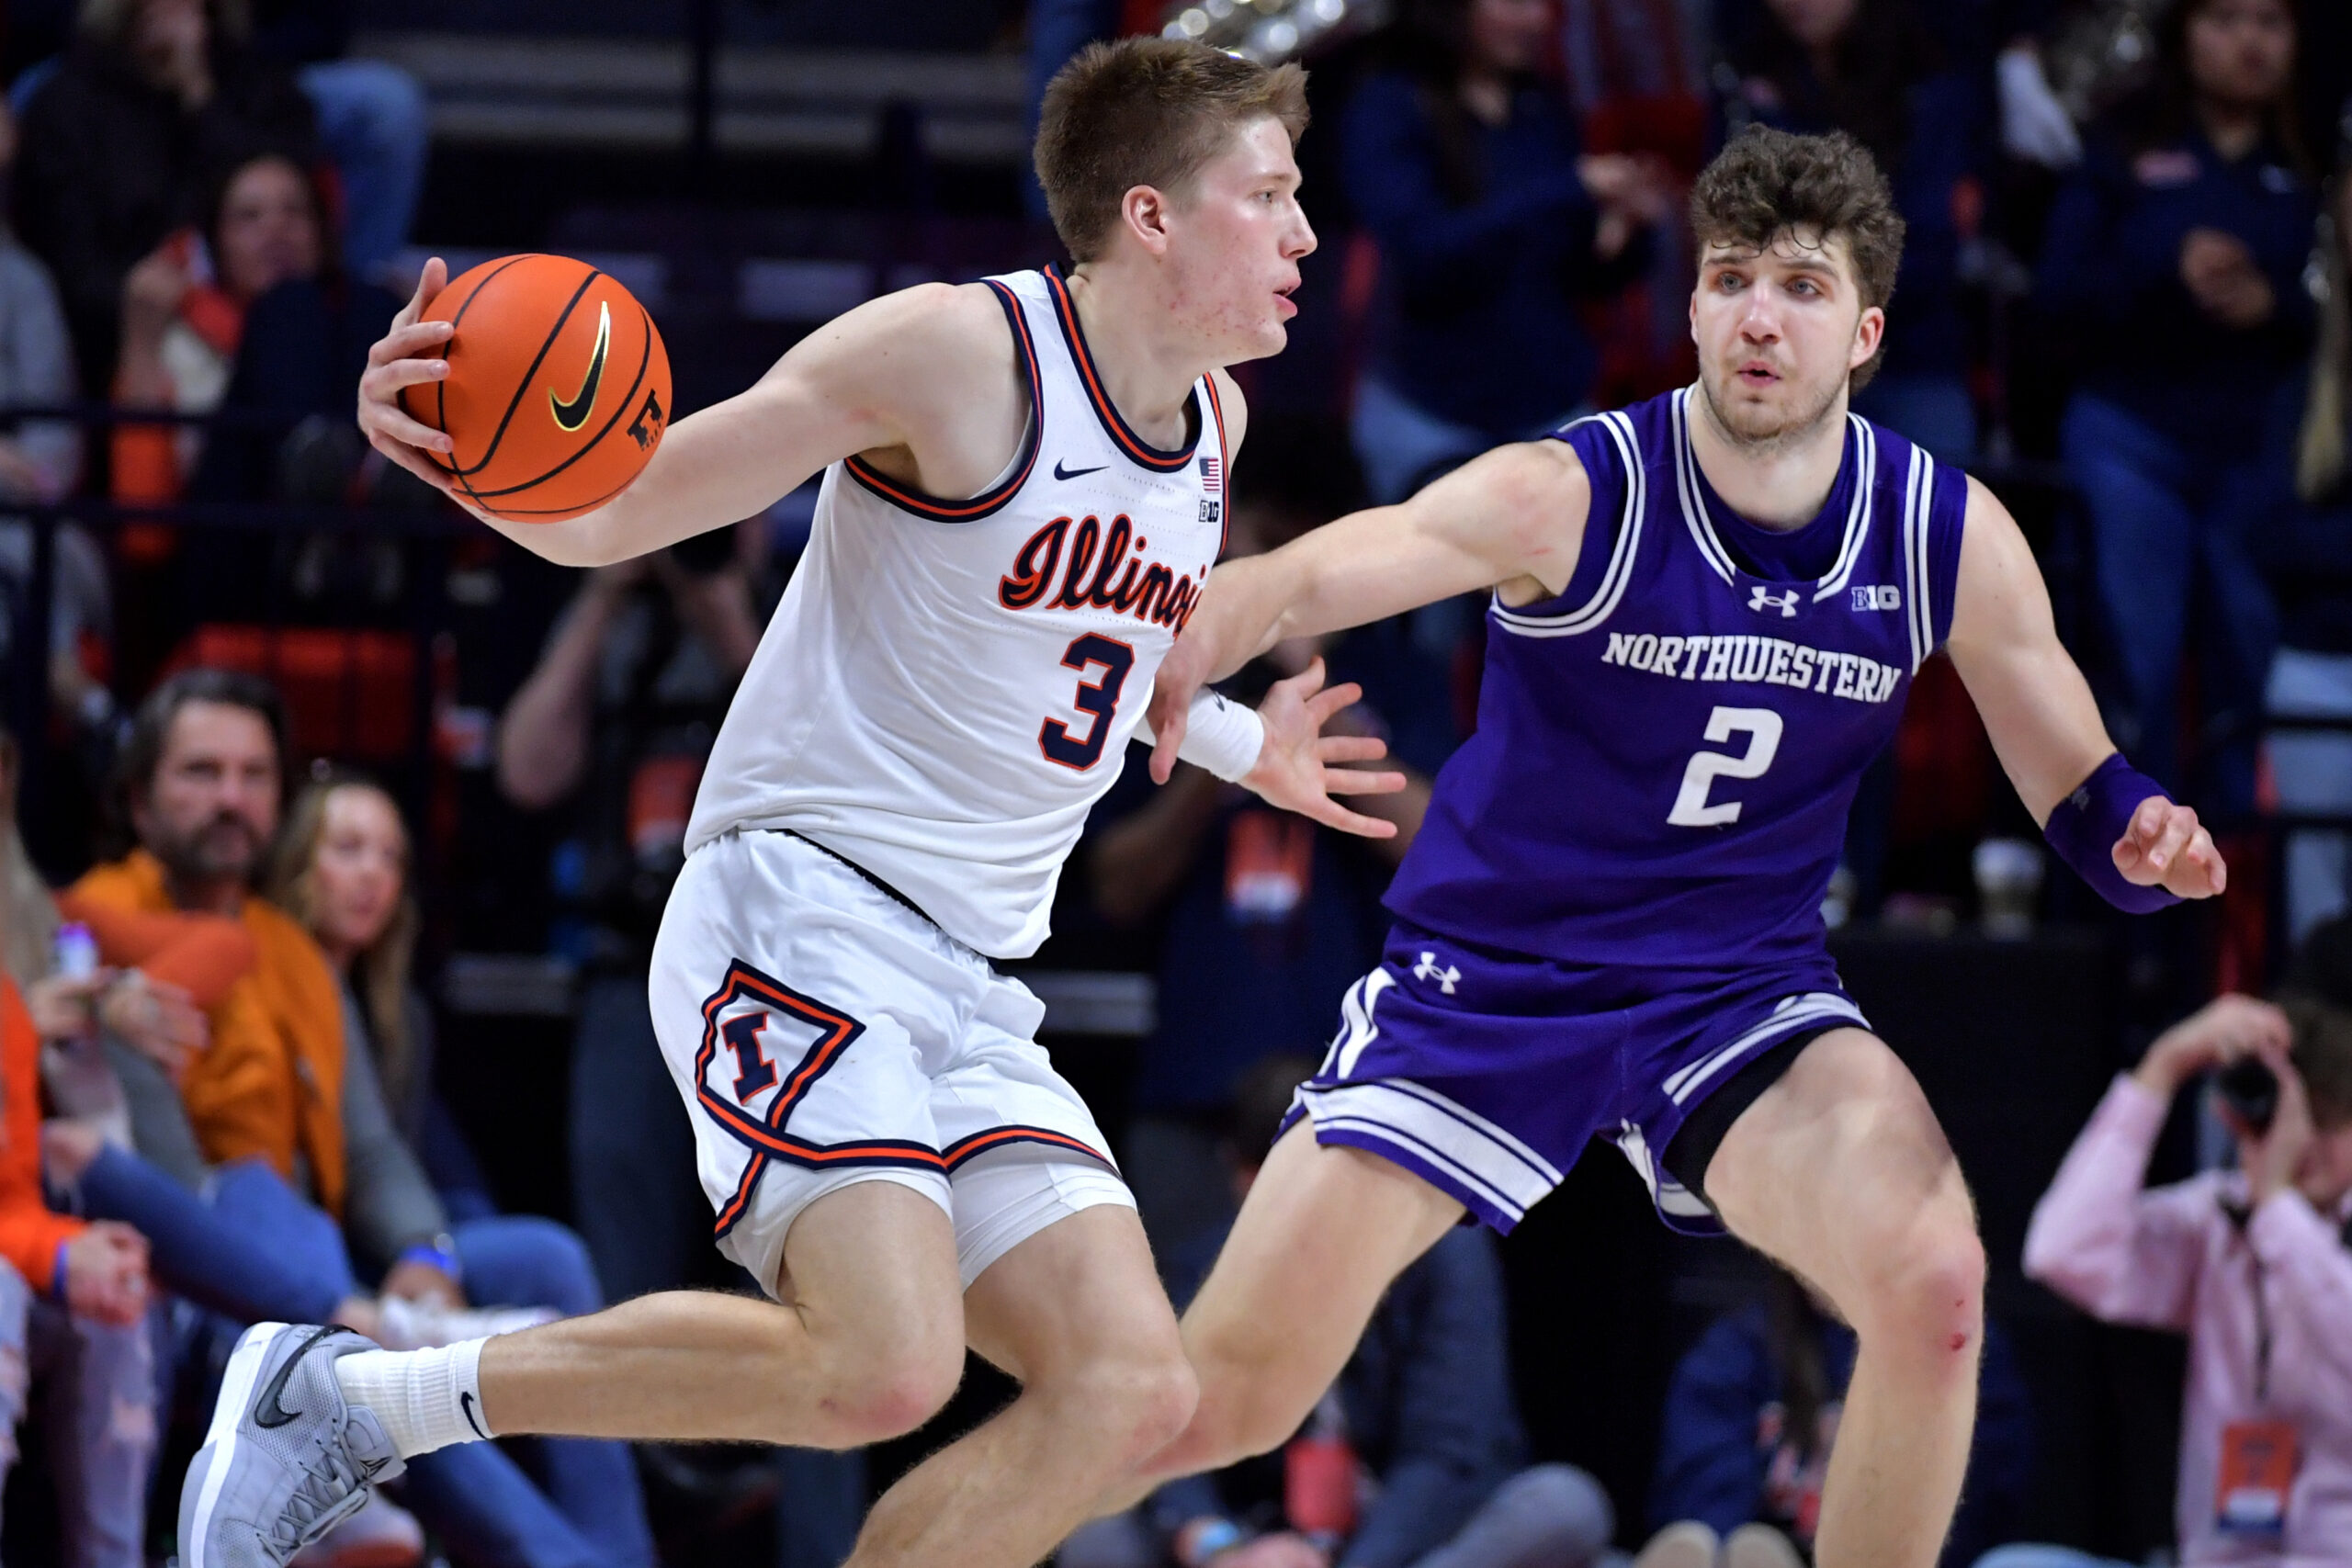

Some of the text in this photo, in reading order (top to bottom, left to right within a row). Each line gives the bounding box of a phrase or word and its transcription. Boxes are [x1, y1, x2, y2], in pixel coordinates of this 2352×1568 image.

[999, 513, 1205, 642] Illinoi
[1038, 631, 1136, 772] 3
[1601, 632, 1903, 704] NORTHWESTERN
[1666, 705, 1784, 827] 2
[721, 1011, 778, 1106] I
